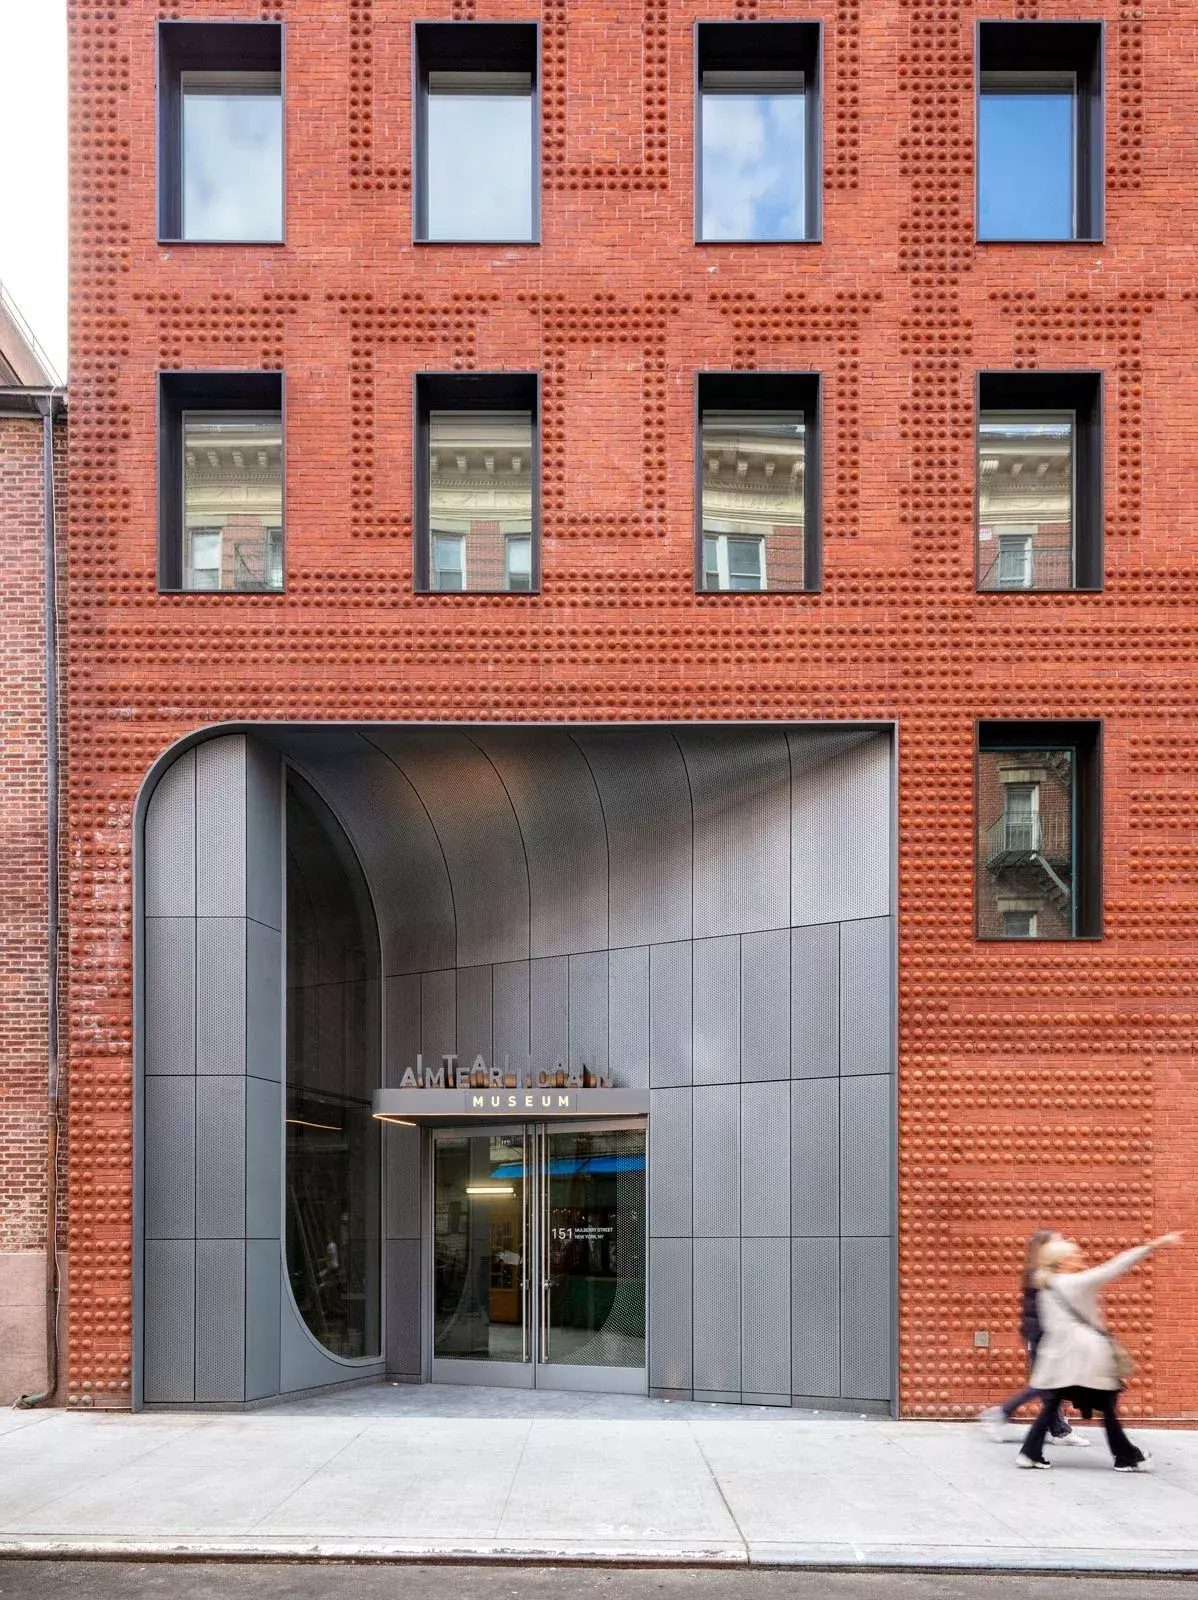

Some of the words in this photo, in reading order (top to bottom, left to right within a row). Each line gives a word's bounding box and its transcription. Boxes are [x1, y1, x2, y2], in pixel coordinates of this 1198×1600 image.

[400, 1066, 613, 1088] AMERICAN
[472, 1095, 569, 1107] MUSEUM
[551, 1228, 572, 1239] 151
